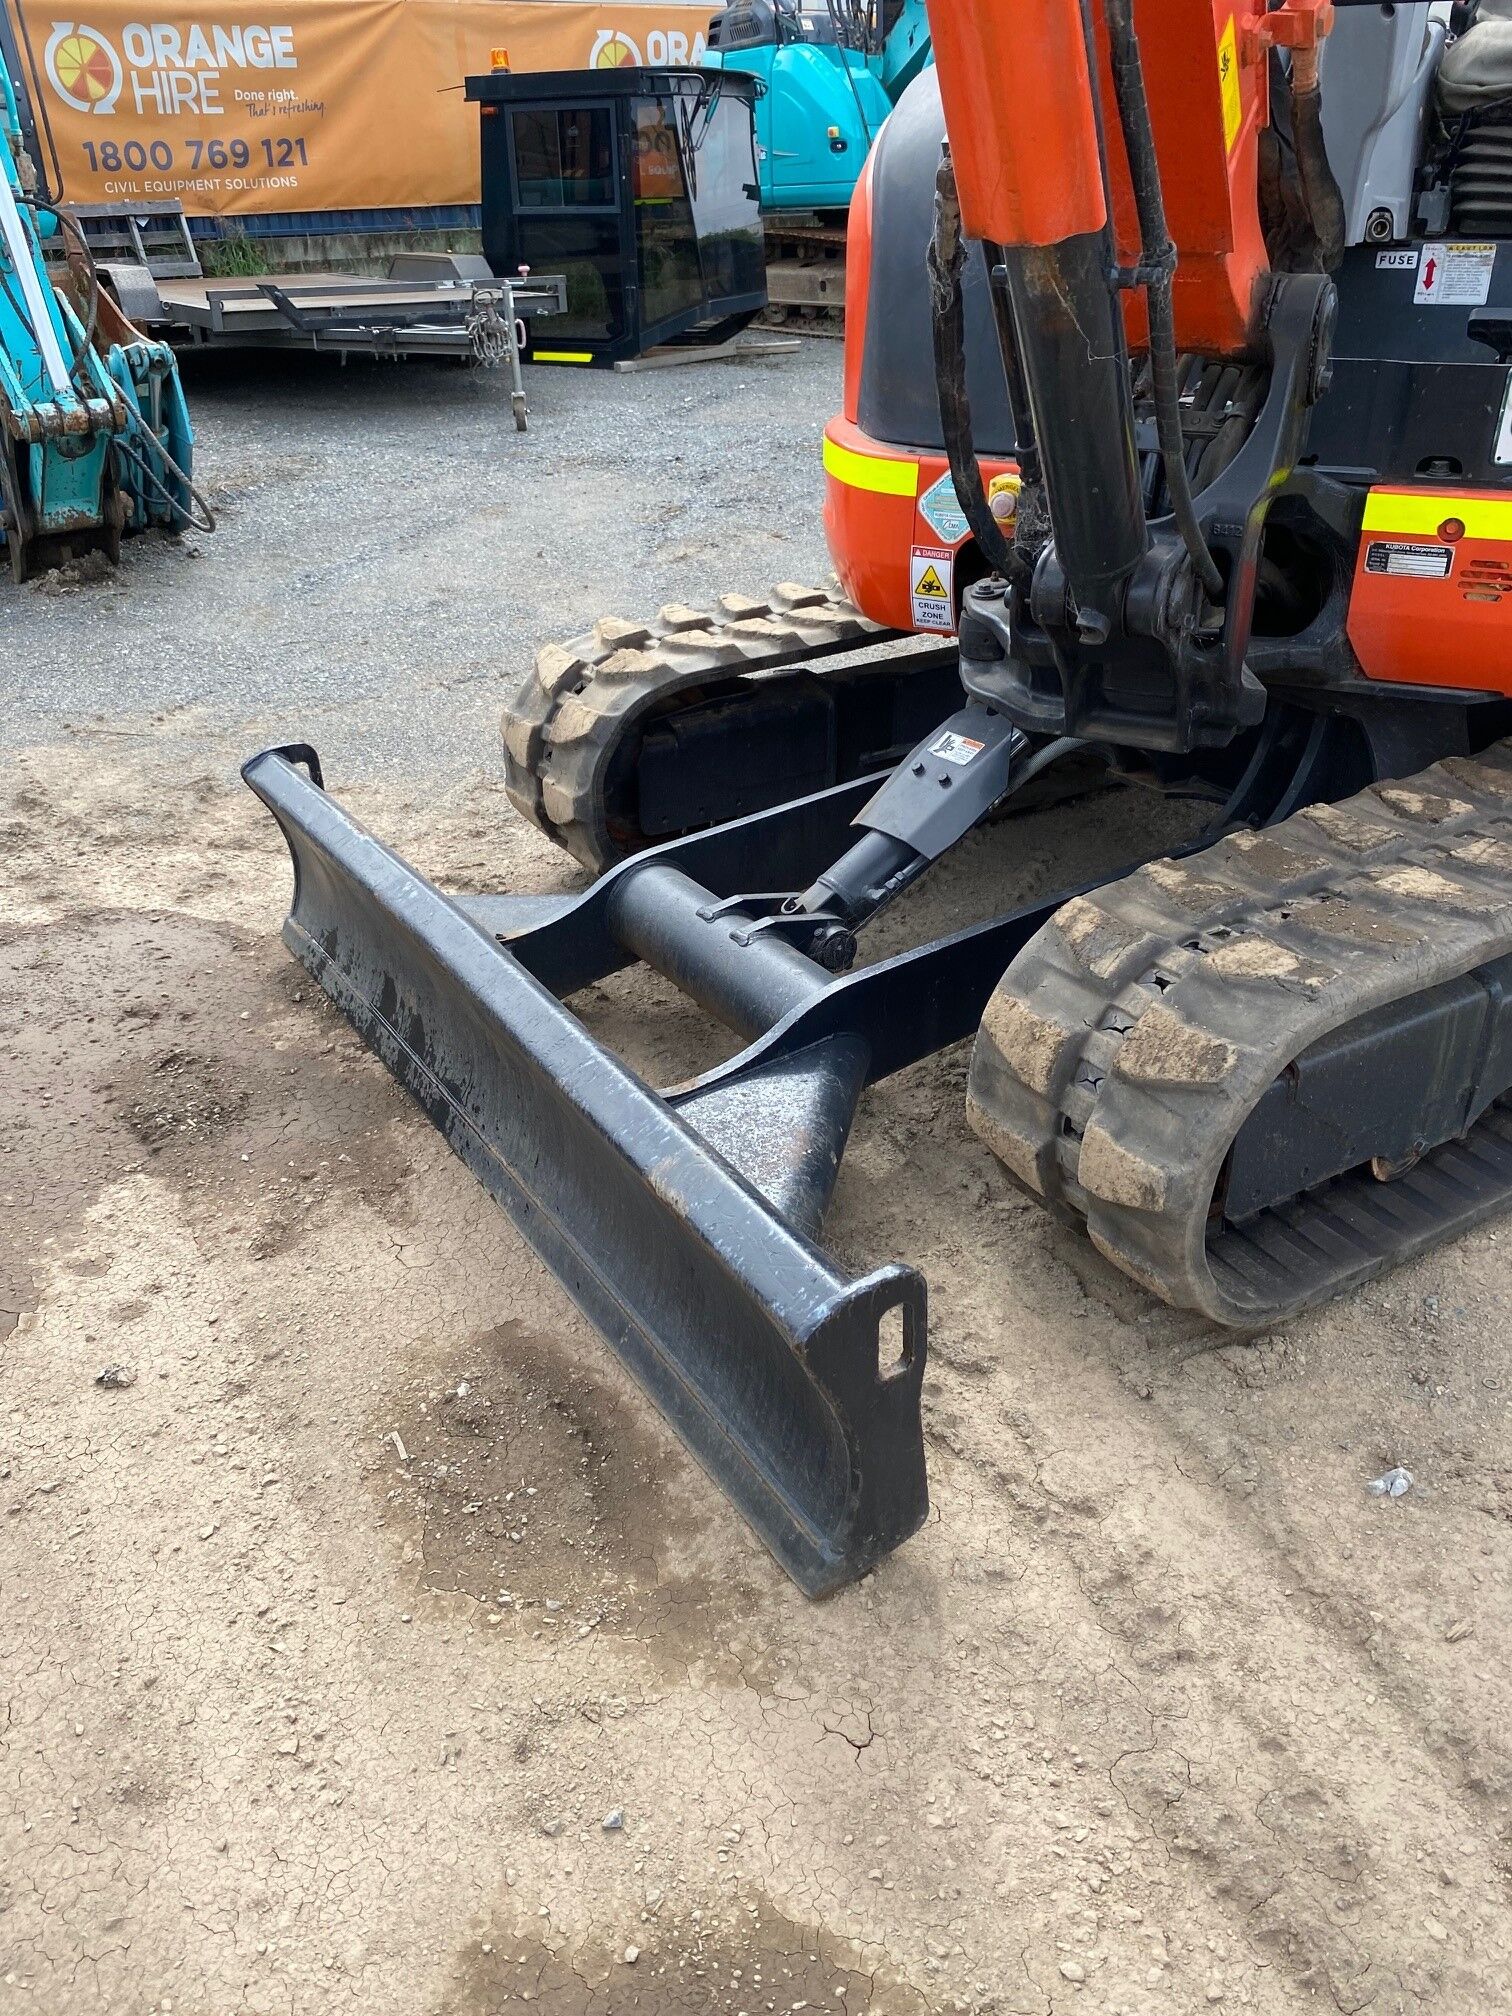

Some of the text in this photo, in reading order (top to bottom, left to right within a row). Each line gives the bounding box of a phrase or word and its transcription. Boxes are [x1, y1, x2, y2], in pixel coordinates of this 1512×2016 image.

[122, 23, 297, 68] ORANGE
[646, 30, 706, 66] ORA
[131, 71, 224, 115] HIRE
[234, 88, 299, 102] Done right.
[246, 98, 326, 118] That's refreshing.
[82, 137, 309, 172] 1800 769 121
[105, 176, 298, 193] CIVIL EQUIPMENT SOLUTIONS
[1379, 255, 1415, 266] FUSE
[922, 549, 950, 559] DANGER
[1411, 545, 1446, 554] Corporation
[918, 602, 946, 611] CRUSH
[922, 611, 944, 620] ZONE
